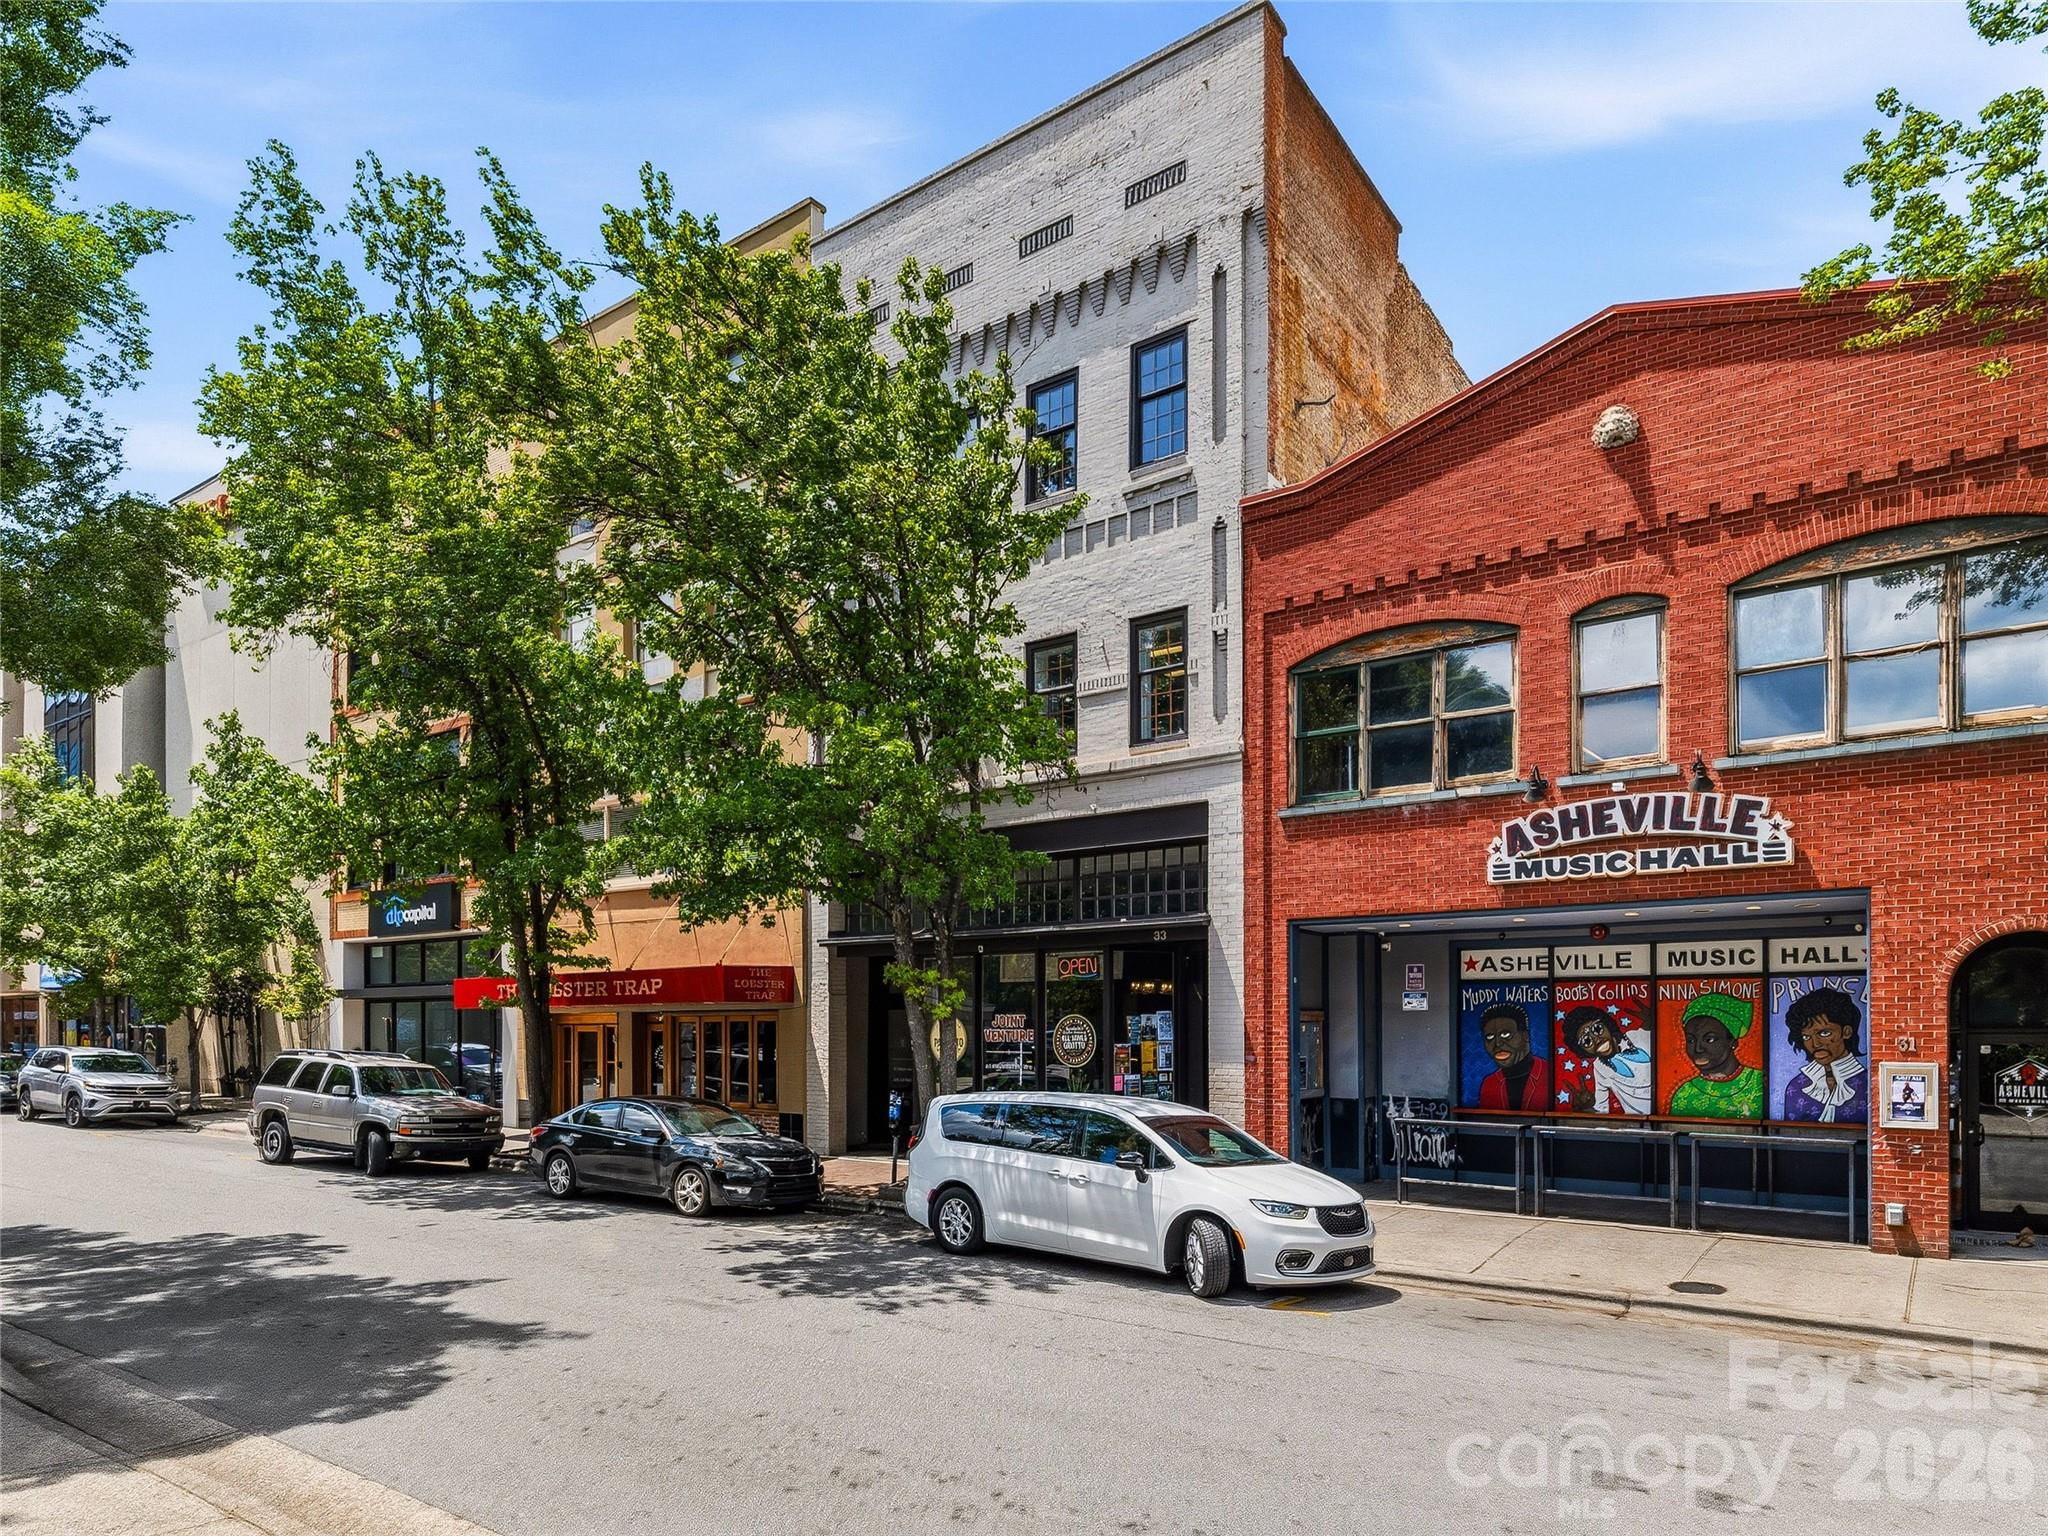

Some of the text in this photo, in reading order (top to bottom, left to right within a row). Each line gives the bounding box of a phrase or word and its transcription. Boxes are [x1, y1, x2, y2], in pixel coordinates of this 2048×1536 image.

[1505, 795, 1765, 857] ASHEVILLE
[1514, 843, 1759, 879] MUSIC HALL
[1153, 930, 1167, 941] 33
[1668, 948, 1756, 967] MUSIC
[1781, 946, 1858, 964] HALL
[749, 968, 772, 977] THE
[1059, 957, 1097, 975] OPEN
[497, 978, 663, 1000] TH BSTER TRAP
[734, 979, 785, 989] LOBSTER
[1659, 979, 1761, 1000] NINA SIMONE
[745, 991, 776, 1000] TRAP
[1463, 985, 1549, 1011] MUDDY WATERS
[992, 1014, 1027, 1028] JOINT
[984, 1029, 1035, 1042] VENTURE
